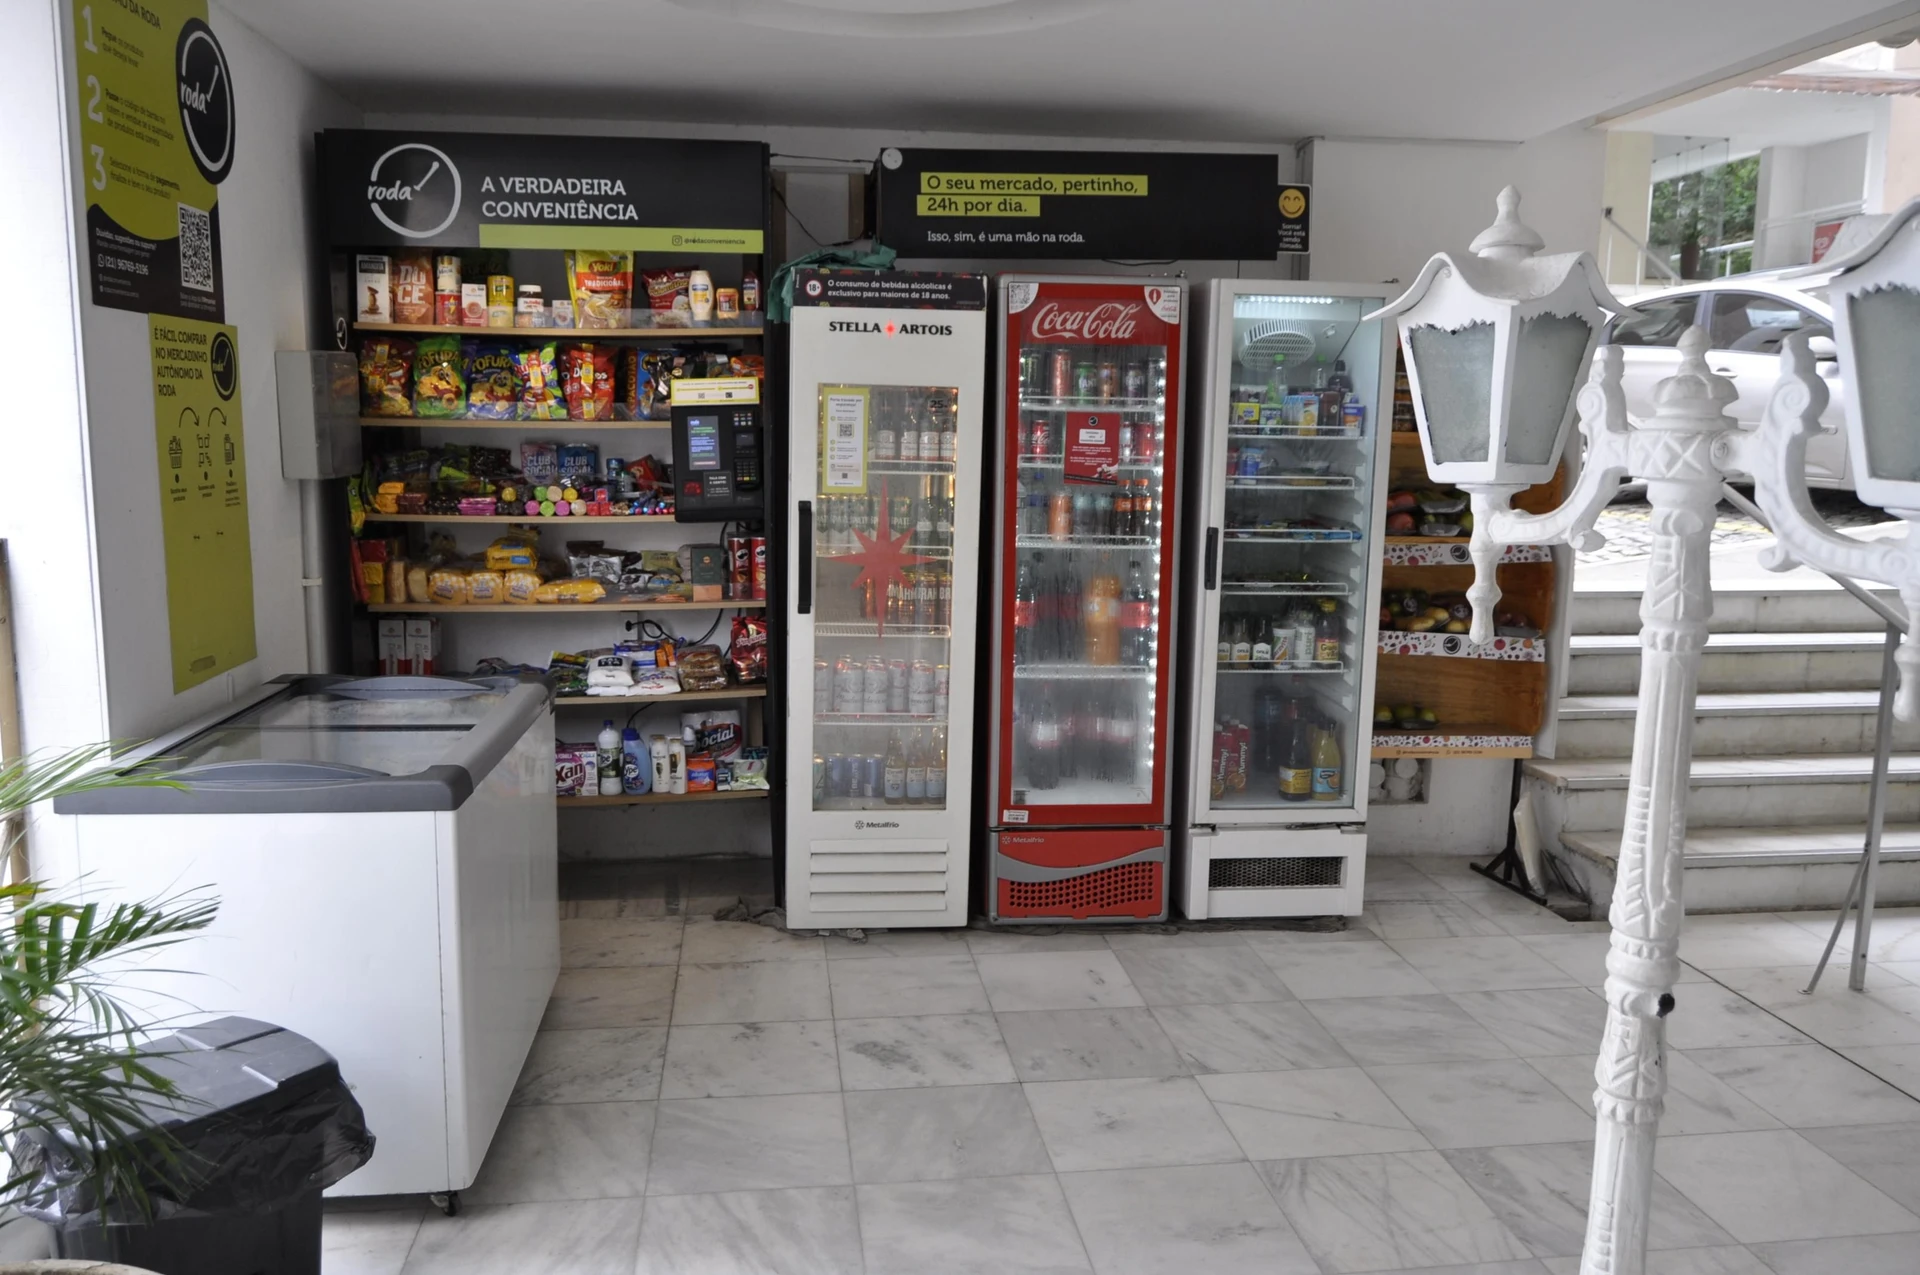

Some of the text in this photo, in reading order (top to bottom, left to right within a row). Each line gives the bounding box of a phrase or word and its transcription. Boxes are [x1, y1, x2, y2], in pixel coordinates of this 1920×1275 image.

[141, 6, 161, 30] RODA
[83, 5, 98, 54] 1
[87, 75, 103, 124] 2
[181, 81, 207, 114] roda
[91, 144, 106, 191] 3
[367, 180, 413, 201] roda
[481, 176, 627, 196] A VERDADEIRA
[927, 175, 1138, 195] O seu mercado, pertinho,
[482, 199, 639, 220] CONVENIÊNCIA
[927, 198, 1027, 215] 24h por dia.
[927, 231, 951, 243] Isso,
[954, 231, 976, 243] sim,
[979, 231, 986, 242] é
[988, 234, 1013, 242] uma
[1015, 232, 1040, 242] mão
[1059, 232, 1085, 243] roda.
[592, 262, 615, 272] Yoki
[835, 280, 870, 288] consumo
[870, 280, 880, 288] de
[881, 280, 909, 289] bebidas
[910, 281, 946, 290] alcóolicas
[863, 291, 880, 299] para
[880, 291, 909, 299] maiores
[910, 291, 920, 299] de
[159, 327, 178, 343] FÁCIL
[178, 331, 207, 346] COMPRAR
[829, 321, 953, 336] STELLA ARTOIS
[155, 347, 207, 363] NO MERCADINHO
[195, 369, 204, 380] DA
[158, 384, 176, 397] RODA
[528, 455, 551, 467] CLUB
[565, 456, 588, 467] CLUB
[700, 724, 735, 748] ocial
[866, 821, 900, 829] Metalfrio
